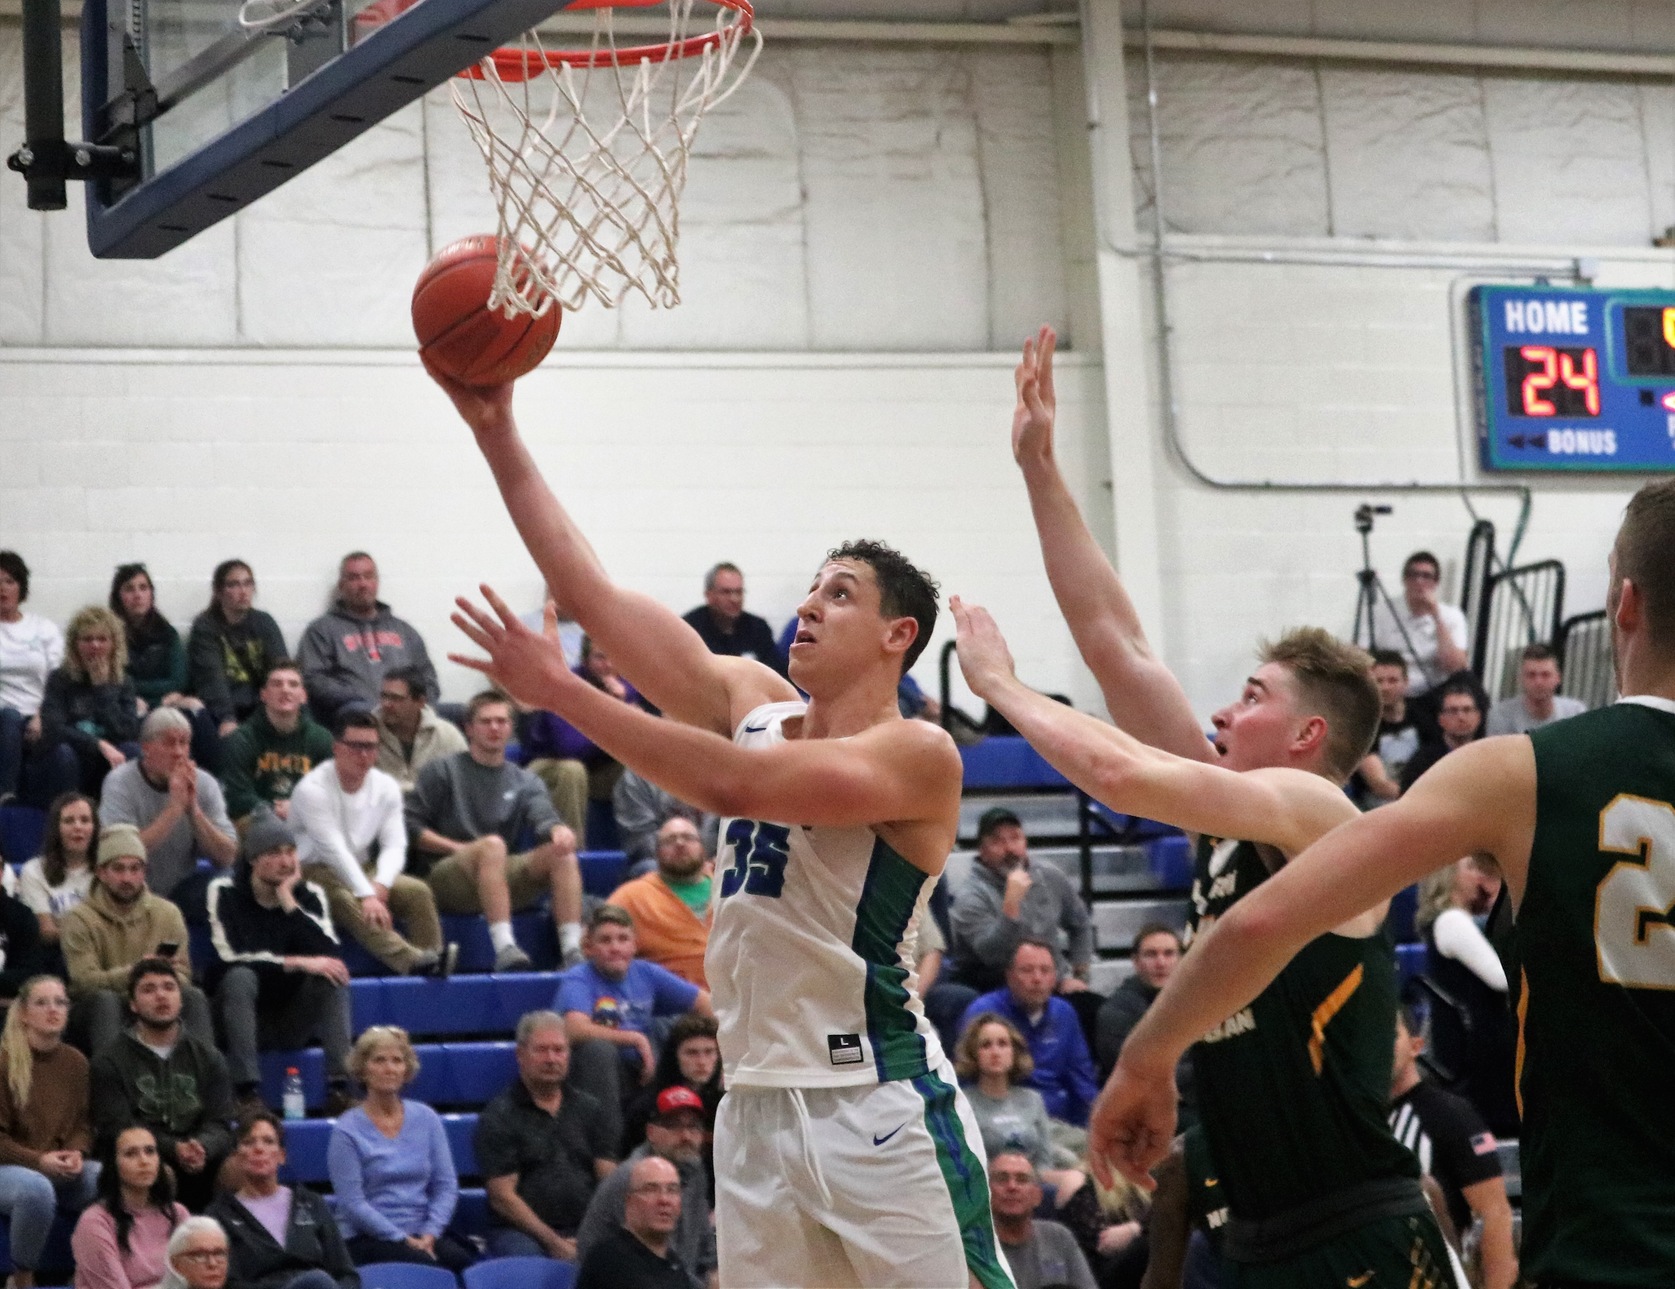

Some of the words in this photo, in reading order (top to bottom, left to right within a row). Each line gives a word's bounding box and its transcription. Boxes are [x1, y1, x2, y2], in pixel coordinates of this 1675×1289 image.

[1504, 301, 1588, 335] HOME
[1520, 346, 1599, 416] 24
[1548, 428, 1616, 455] BONUS
[720, 818, 791, 899] 35
[1594, 793, 1675, 990] 2
[840, 1037, 849, 1046] L
